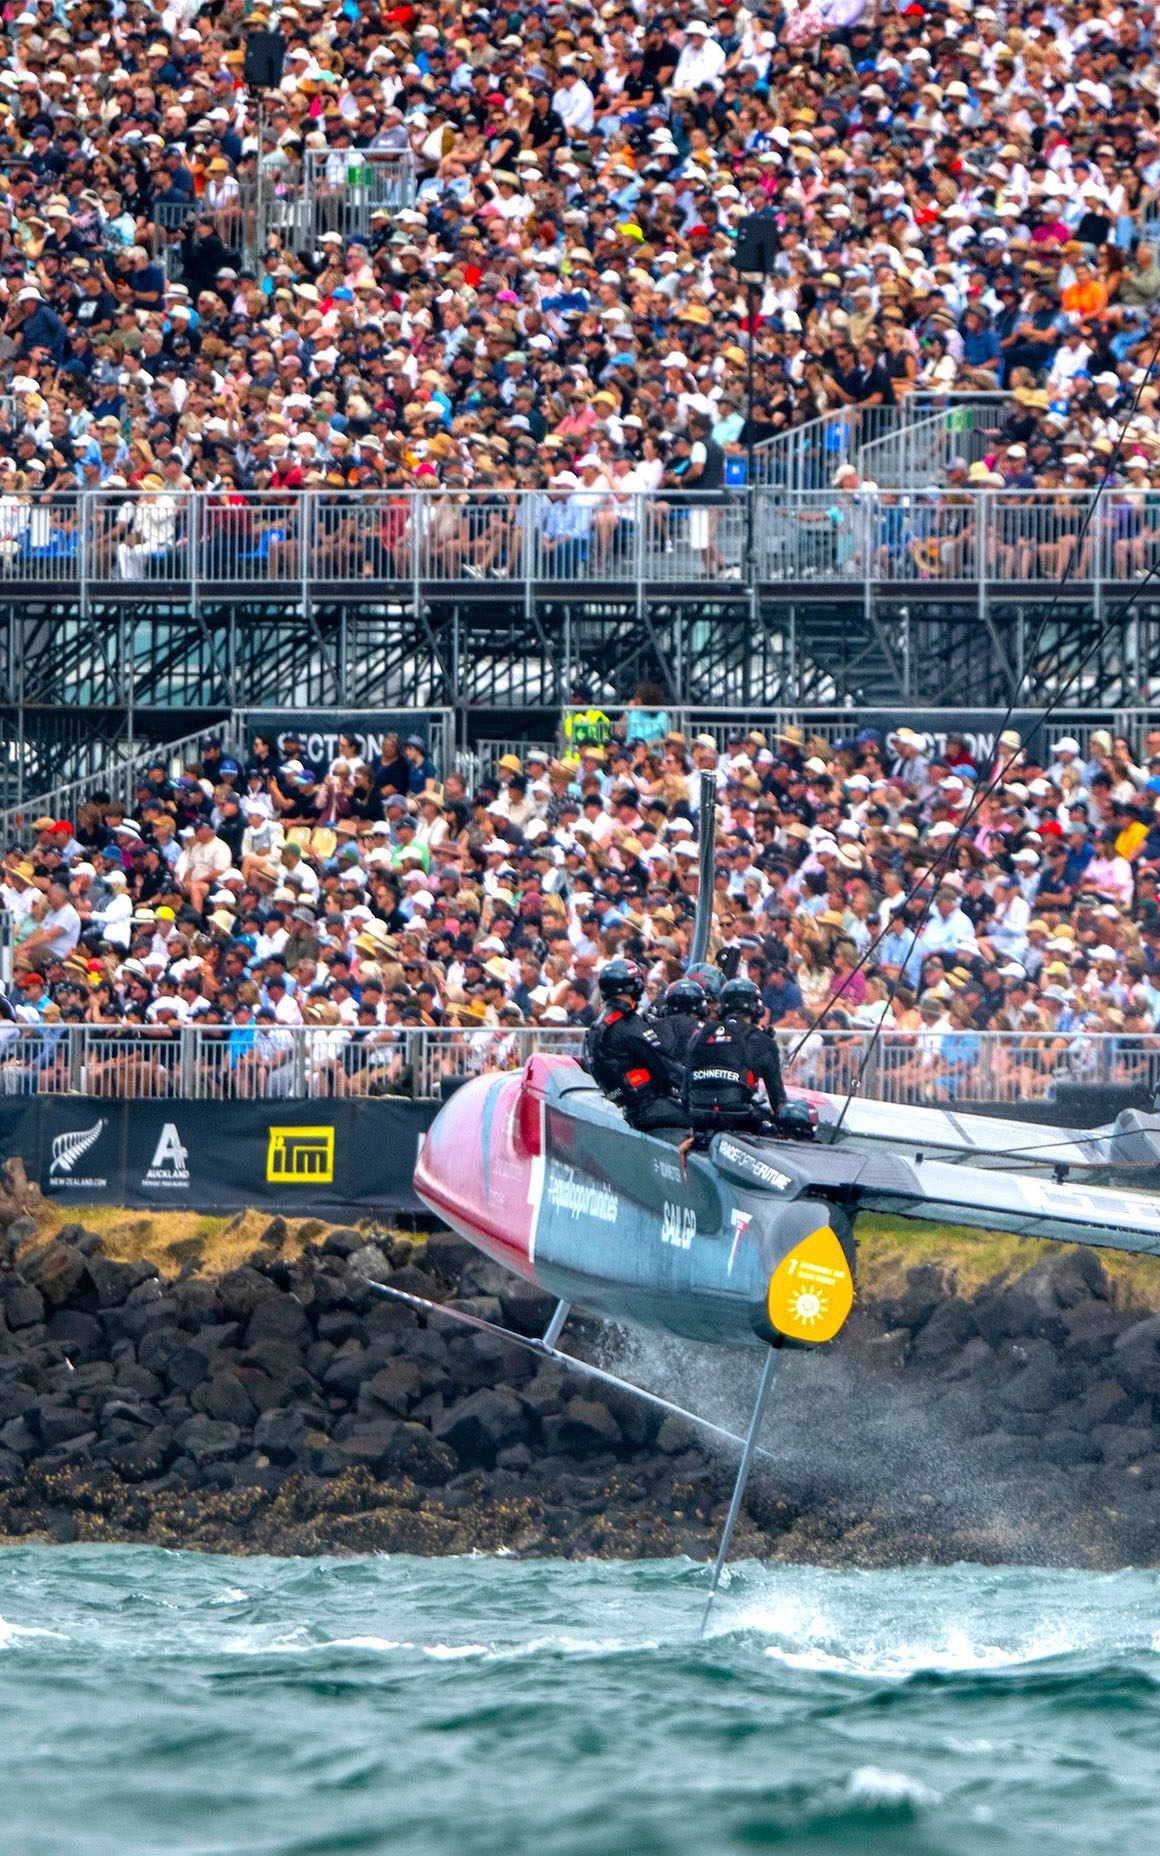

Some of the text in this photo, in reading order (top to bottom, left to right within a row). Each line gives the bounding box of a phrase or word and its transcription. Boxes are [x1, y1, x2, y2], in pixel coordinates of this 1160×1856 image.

[277, 732, 384, 762] SCTON
[885, 732, 995, 761] SCTON
[693, 1069, 740, 1082] SCHNEITER
[788, 1258, 798, 1275] 7
